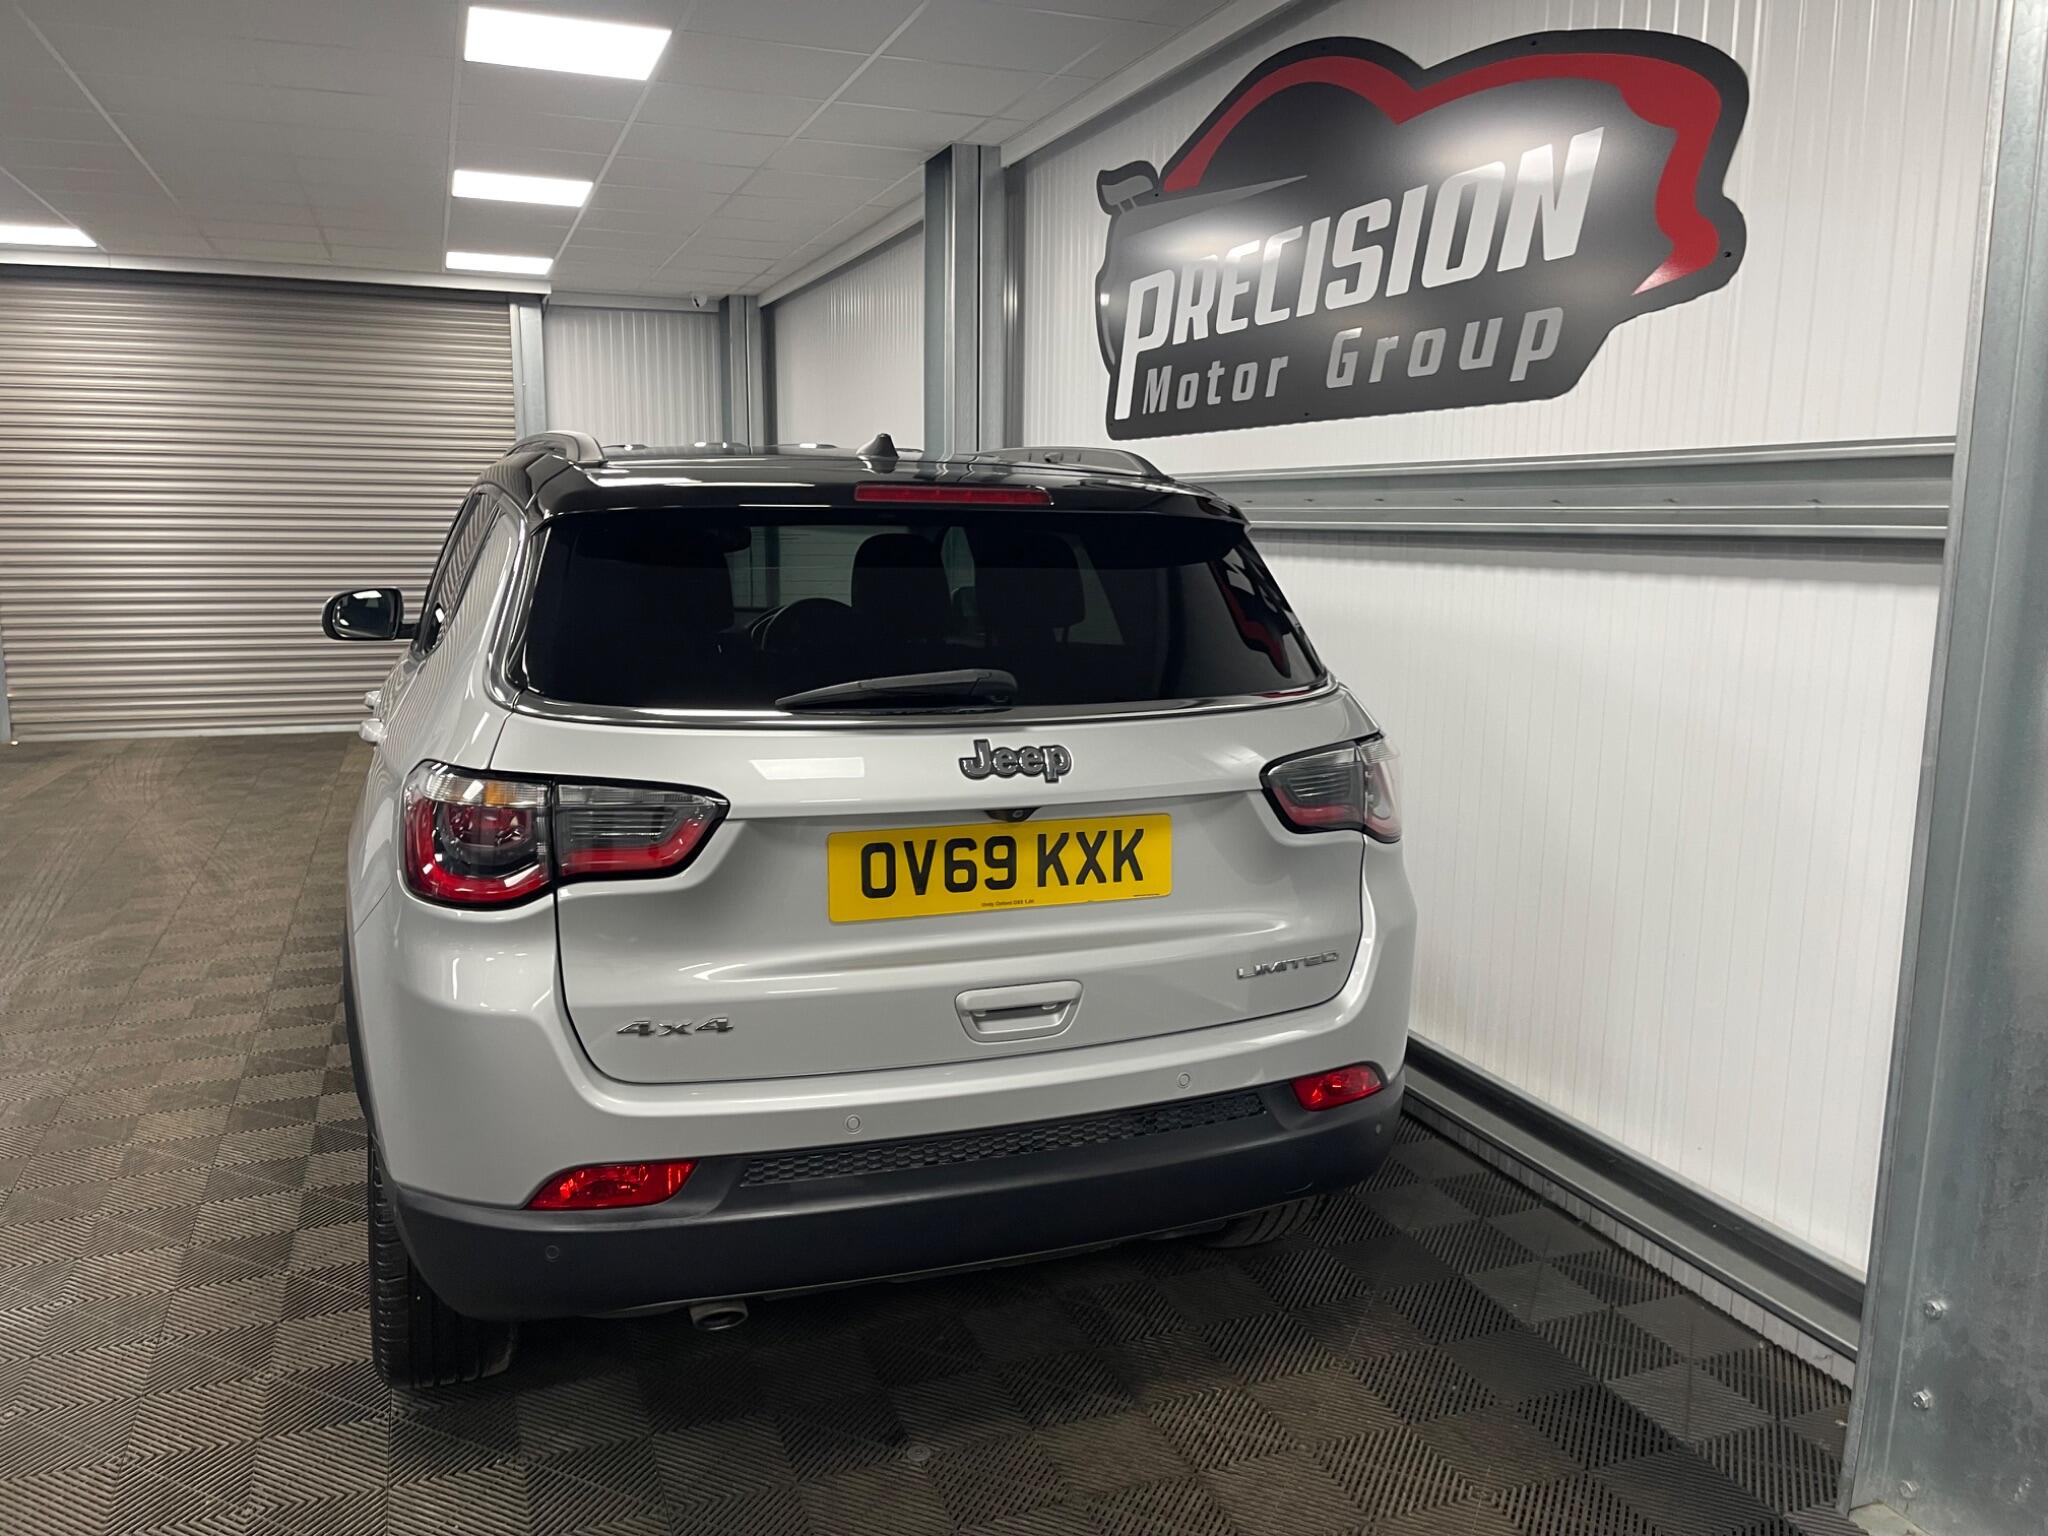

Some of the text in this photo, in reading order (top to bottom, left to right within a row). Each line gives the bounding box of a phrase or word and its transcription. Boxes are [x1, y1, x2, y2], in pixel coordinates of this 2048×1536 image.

[1114, 127, 1604, 420] PRECISION
[1143, 307, 1564, 413] Motor Group
[959, 739, 1072, 783] Jeep
[861, 828, 1144, 899] OV69 KXK
[1237, 952, 1338, 979] LIMITED
